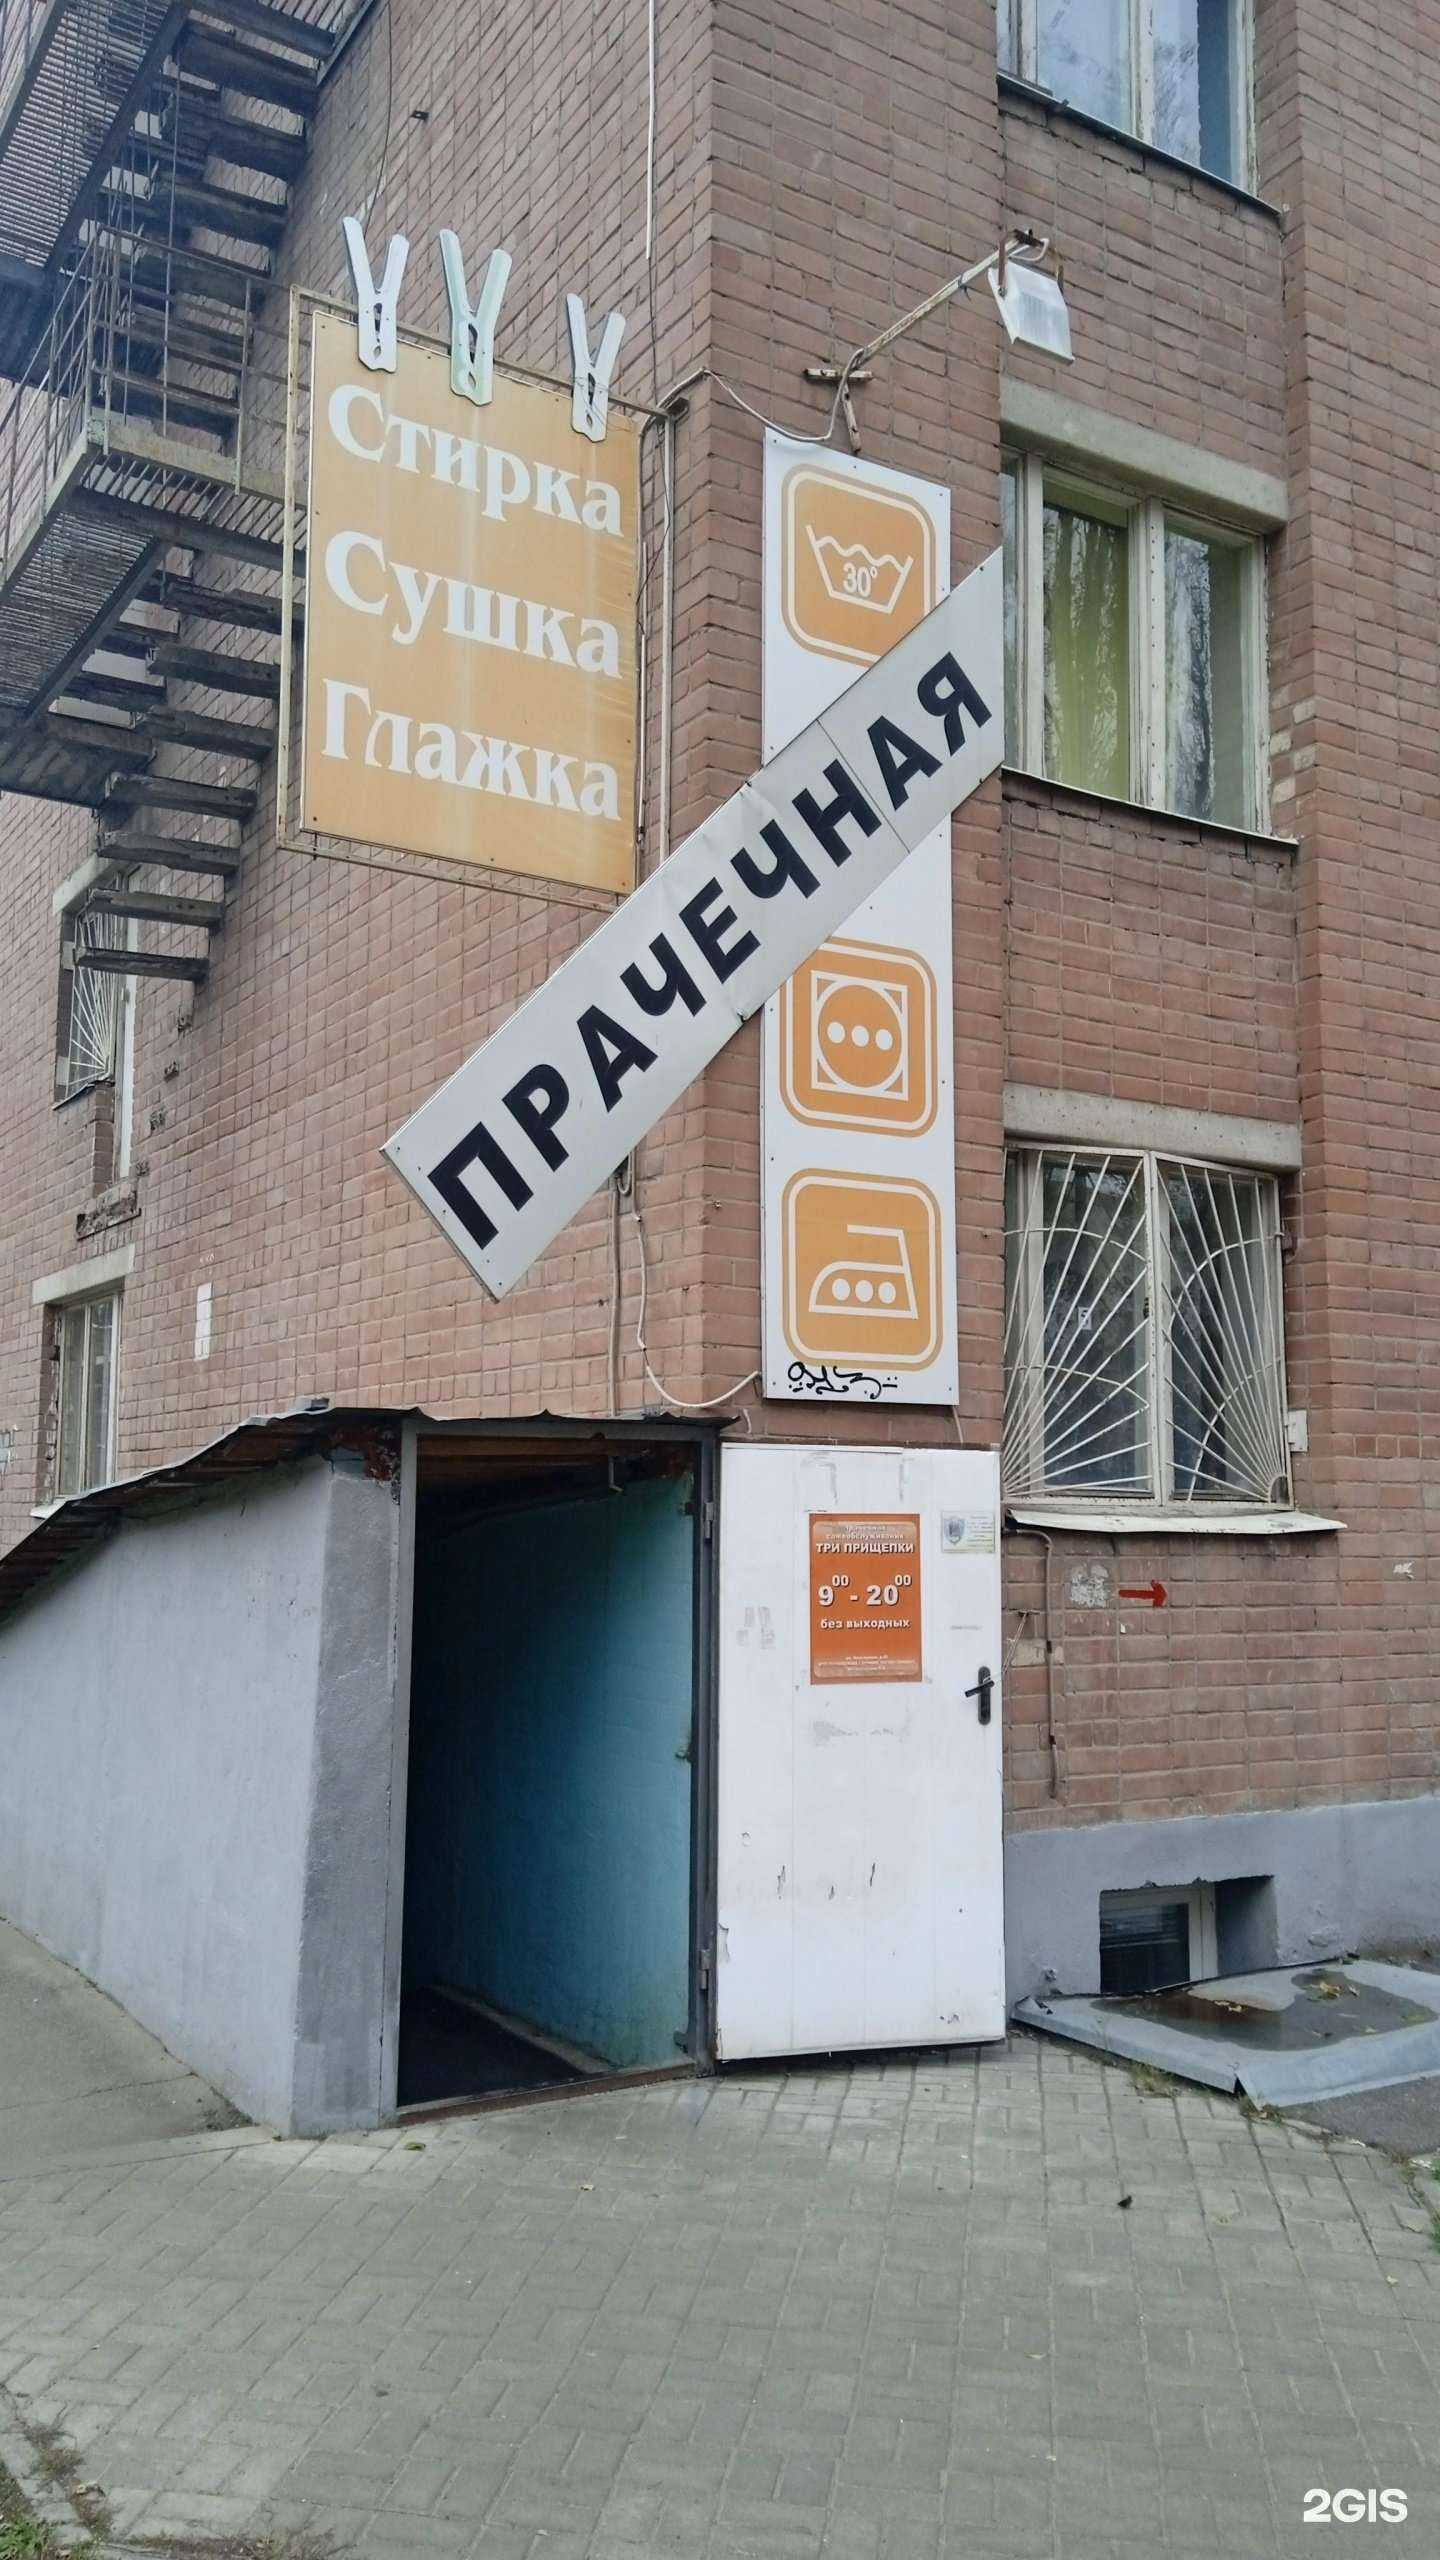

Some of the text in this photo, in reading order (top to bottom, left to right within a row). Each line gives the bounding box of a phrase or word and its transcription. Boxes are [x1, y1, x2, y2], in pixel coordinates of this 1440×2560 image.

[327, 383, 624, 537] Стирка
[323, 529, 624, 680] Сушка
[321, 678, 622, 821] Глажка
[427, 651, 992, 1250] ПРАЧЕЧНАЯ
[816, 1543, 915, 1555] ТРИ ПРИЩЕПКИ
[820, 1619, 910, 1630] без выходных
